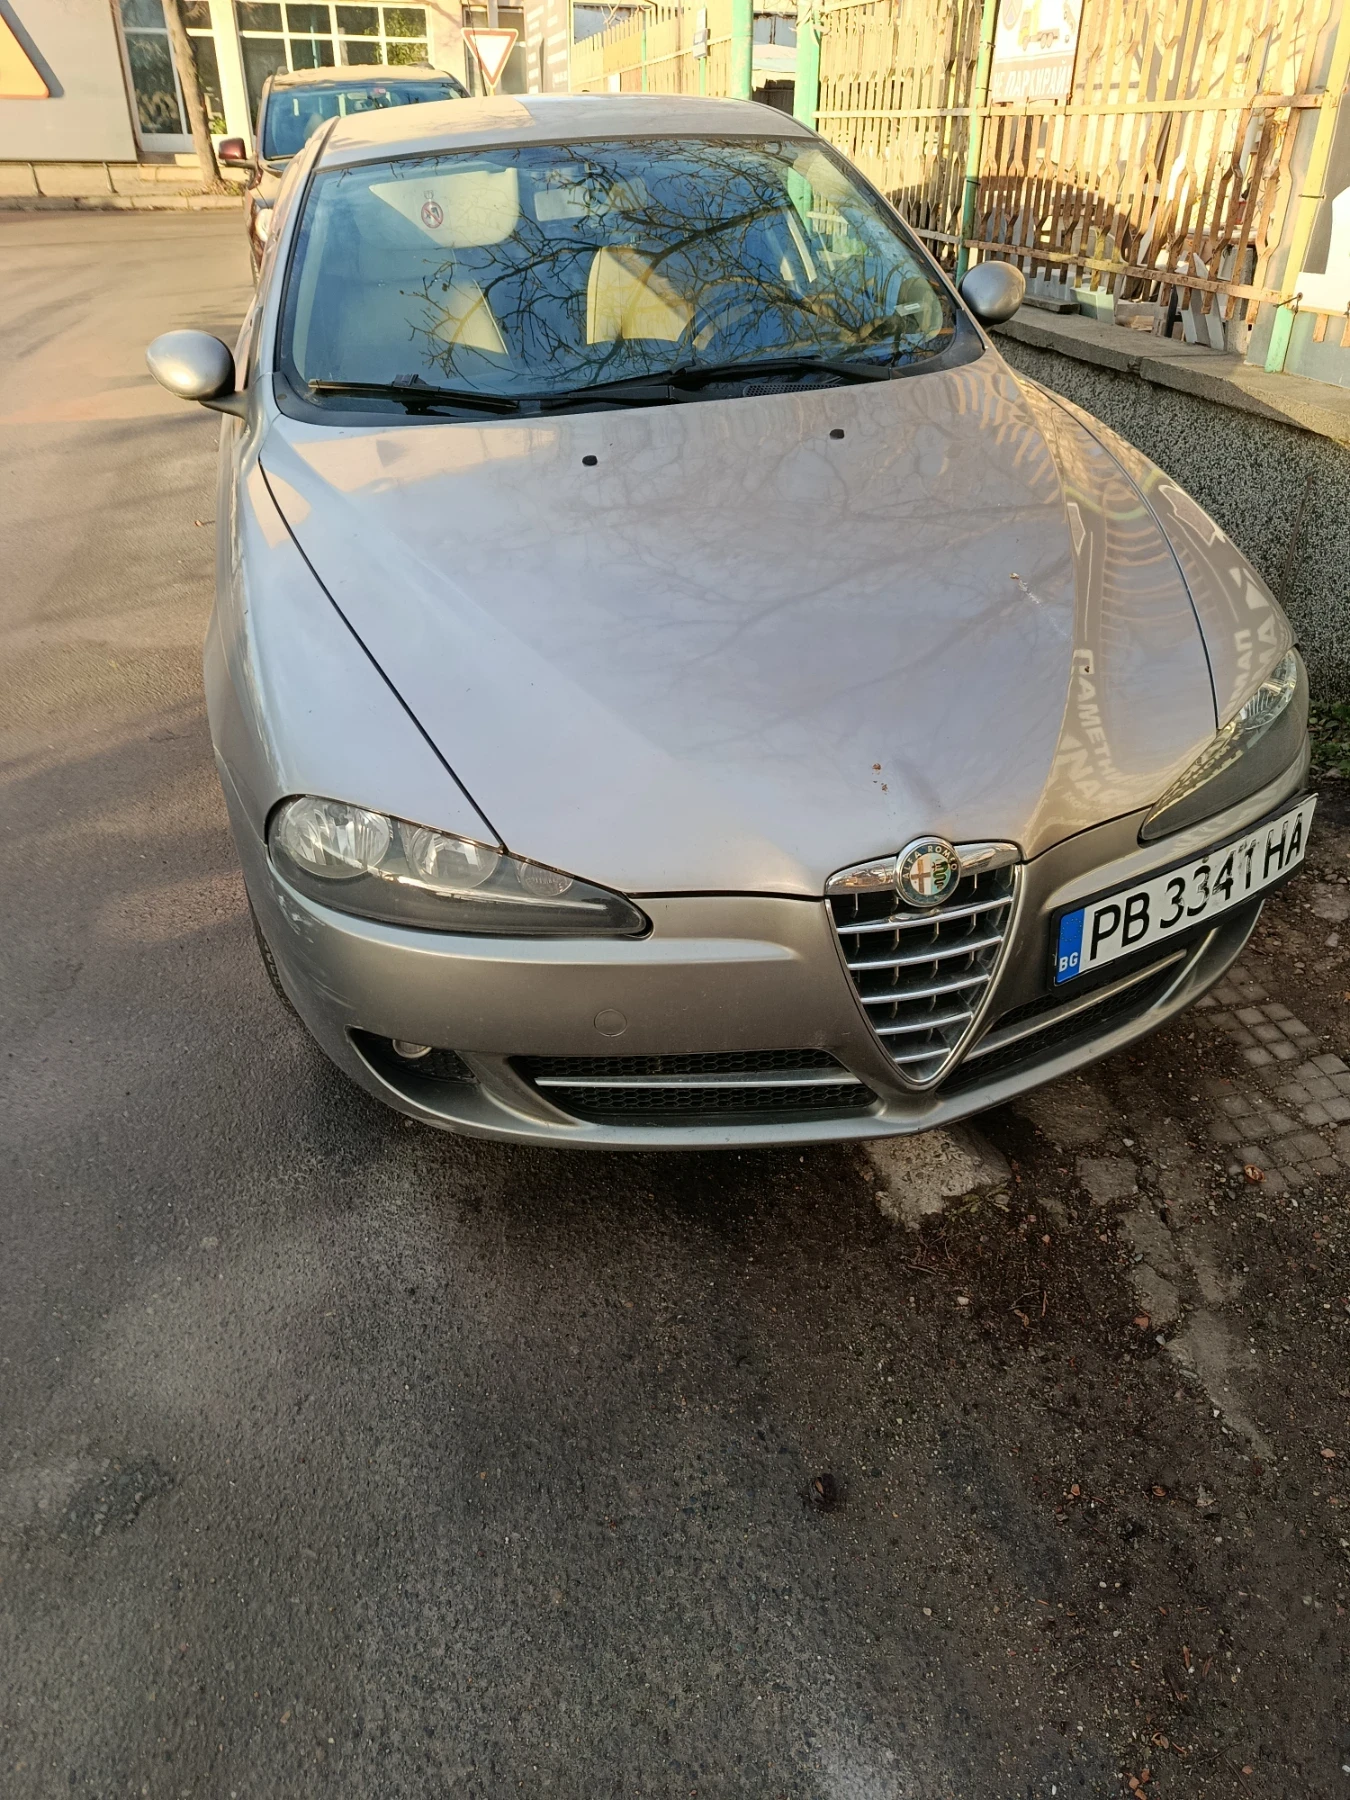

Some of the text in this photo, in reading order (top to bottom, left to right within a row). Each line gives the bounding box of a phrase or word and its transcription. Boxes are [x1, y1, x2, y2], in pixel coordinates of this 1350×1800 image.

[991, 71, 1005, 97] НЕ
[902, 845, 958, 880] ALFA ROMEO
[1089, 812, 1303, 961] PB 3341 HA
[1058, 951, 1079, 973] BG
